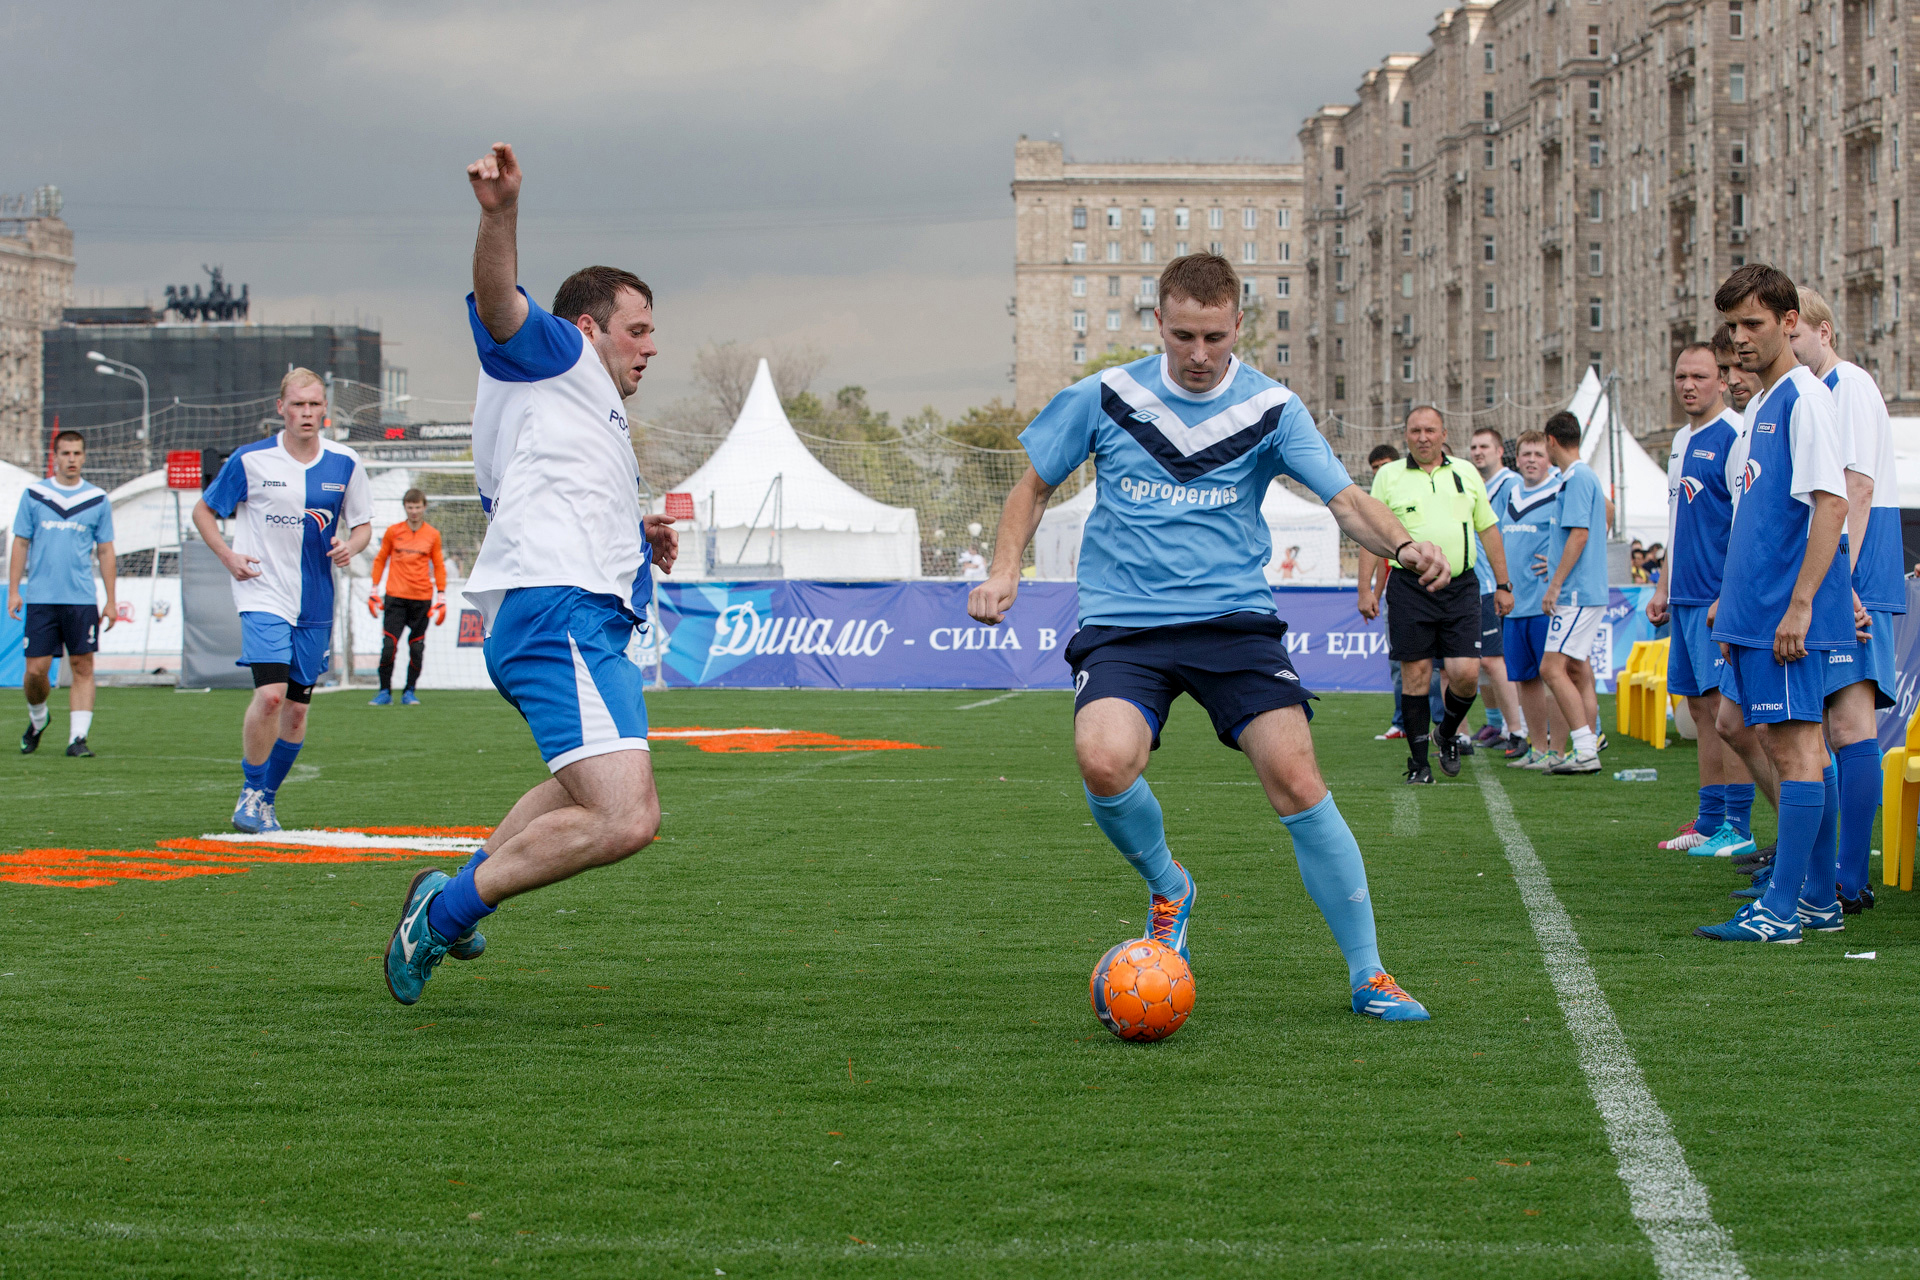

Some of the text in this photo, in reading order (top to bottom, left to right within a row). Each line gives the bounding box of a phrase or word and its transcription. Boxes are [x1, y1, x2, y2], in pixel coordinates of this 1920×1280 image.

[609, 409, 628, 431] РО
[709, 600, 894, 657] Динамо
[929, 628, 1021, 650] СИЛА
[1038, 628, 1057, 650] В
[1326, 632, 1389, 659] ЕДИ
[1552, 616, 1563, 632] 6
[1829, 655, 1853, 664] oma
